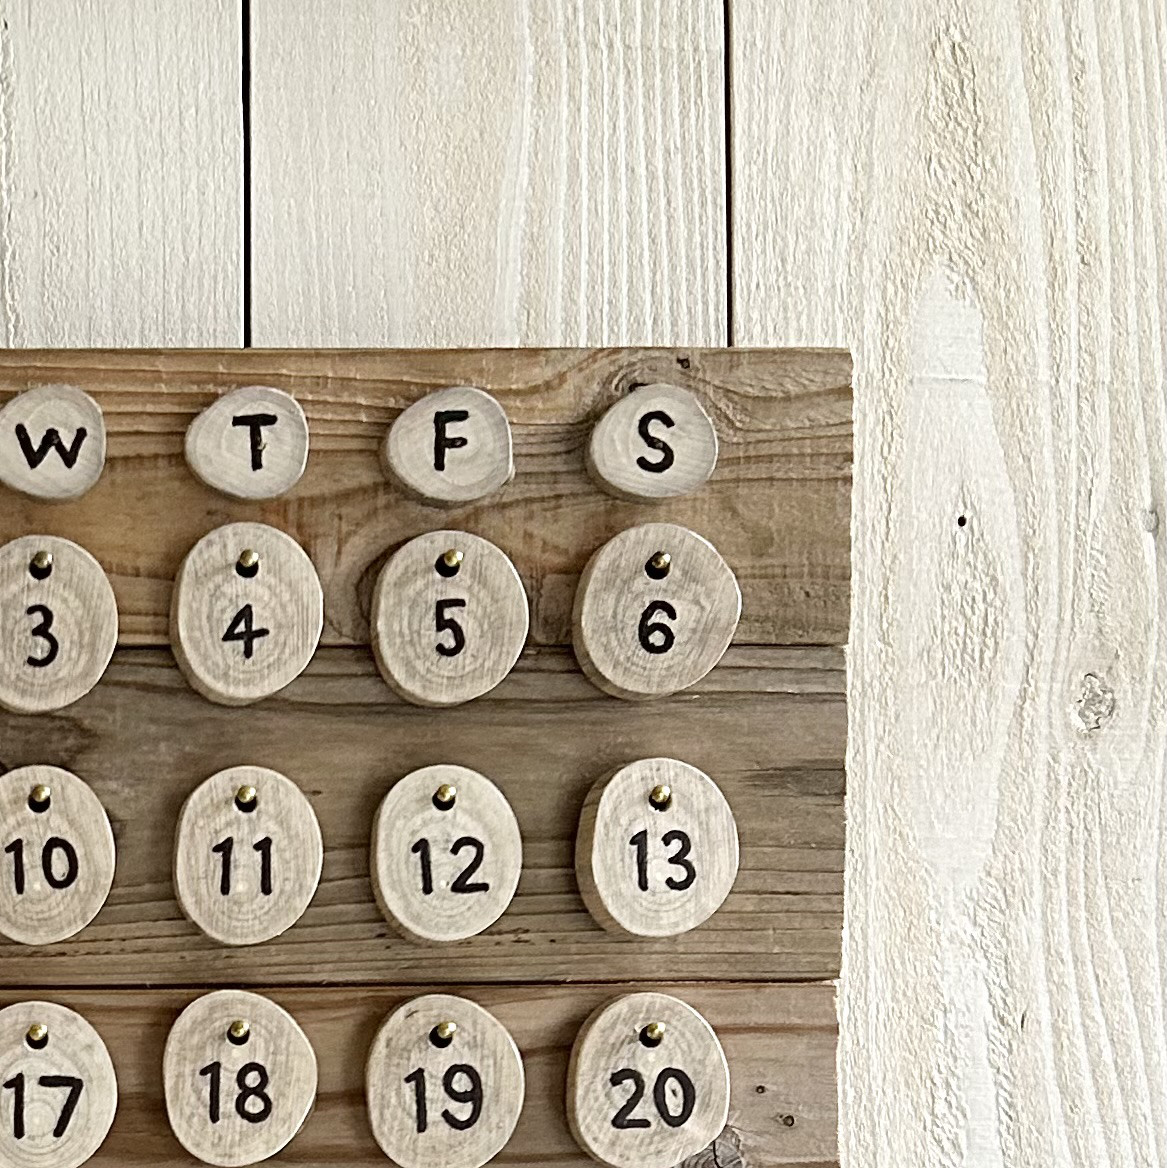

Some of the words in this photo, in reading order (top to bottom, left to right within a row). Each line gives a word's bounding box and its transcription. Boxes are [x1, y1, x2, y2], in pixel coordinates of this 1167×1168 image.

[15, 424, 87, 469] W
[232, 414, 277, 471] T
[434, 410, 469, 471] F
[637, 411, 675, 473] S
[25, 605, 58, 667] 3
[222, 604, 269, 659] 4
[435, 599, 466, 657] 5
[638, 600, 676, 654] 6
[5, 837, 78, 894] 10
[212, 837, 272, 896] 11
[412, 837, 489, 895] 12
[630, 829, 696, 891] 13
[3, 1073, 83, 1139] 17
[199, 1061, 272, 1123] 18
[404, 1064, 483, 1133] 19
[609, 1067, 695, 1129] 20
